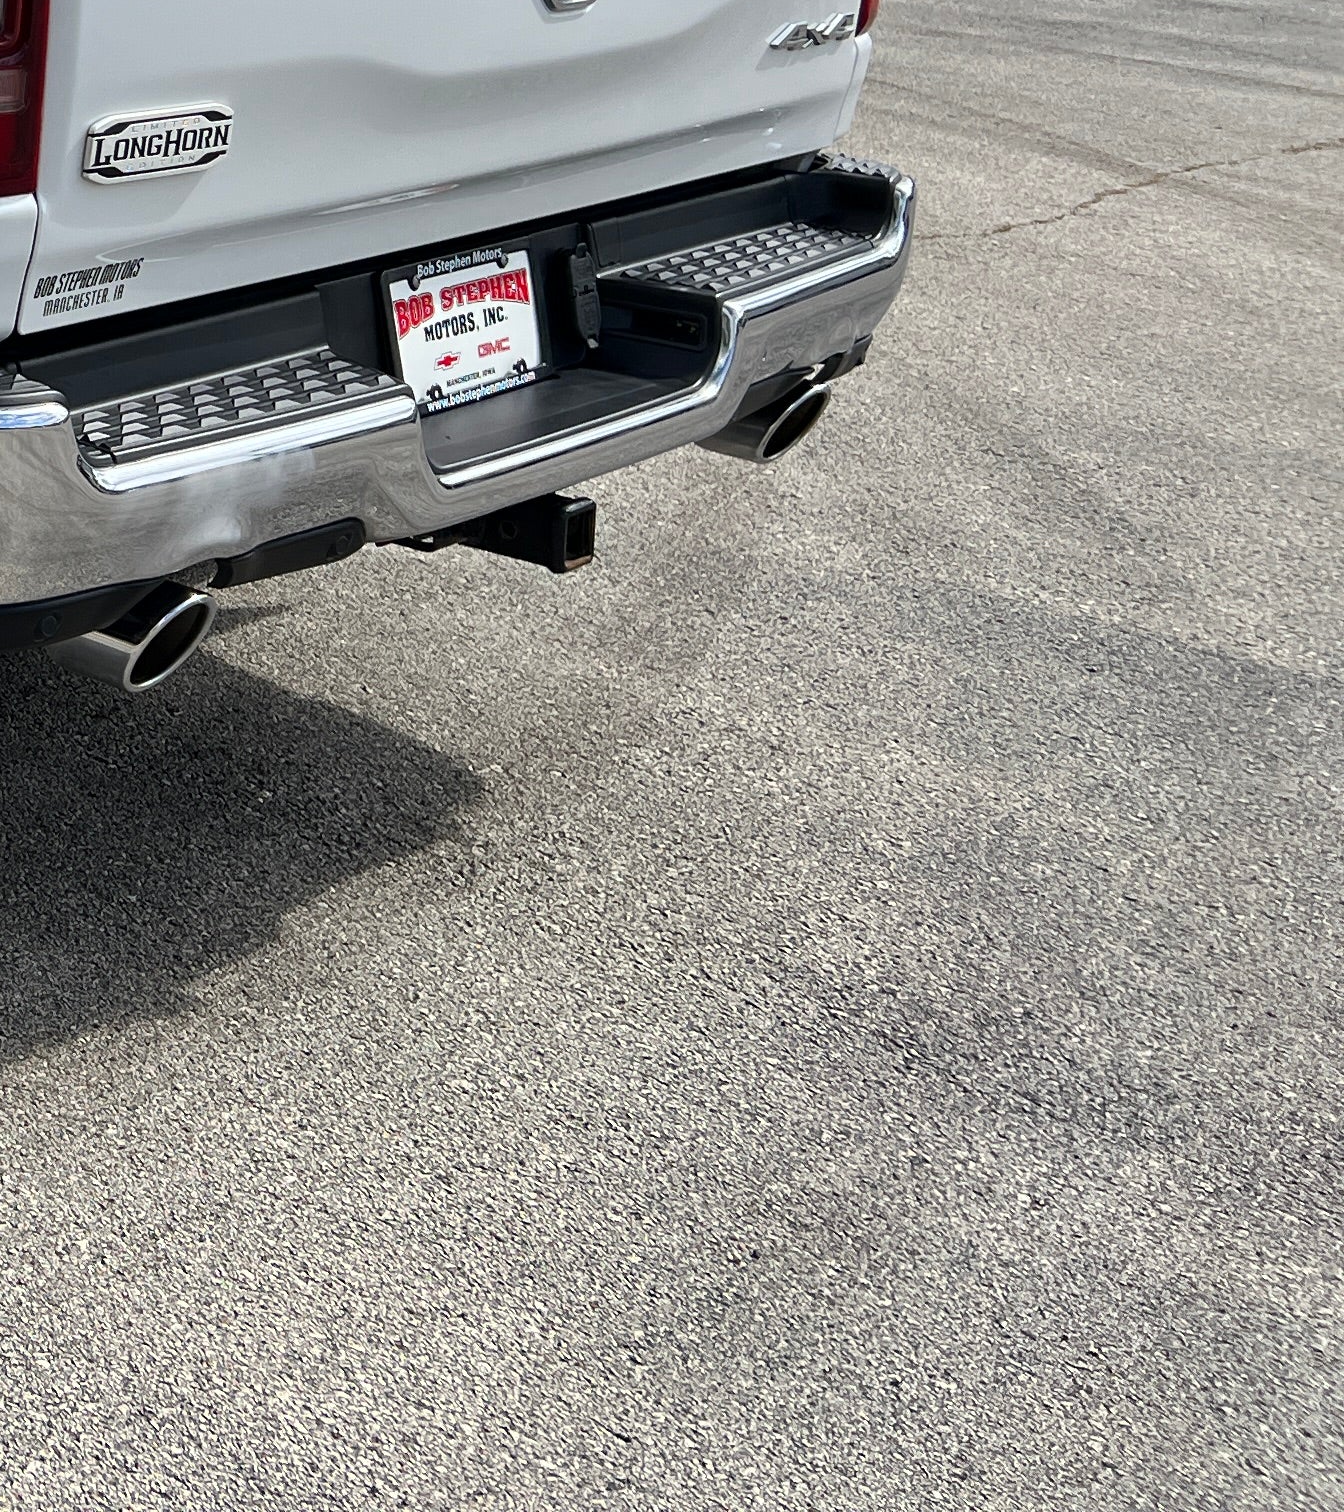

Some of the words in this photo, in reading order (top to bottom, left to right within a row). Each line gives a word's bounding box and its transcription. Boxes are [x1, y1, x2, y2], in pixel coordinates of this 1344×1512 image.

[131, 117, 201, 133] LIMITED
[91, 123, 232, 168] LONGHORN
[125, 154, 196, 172] EDITION
[33, 275, 58, 299] BOB
[56, 266, 103, 294] STEPHEN
[99, 257, 144, 285] MOTORS
[417, 262, 434, 279] Bob
[435, 255, 471, 273] Stephen
[472, 248, 502, 264] Motors
[113, 284, 125, 302] IA
[393, 292, 435, 340] BOB
[439, 267, 531, 311] STEPHEN
[424, 311, 480, 342] MOTORS,
[482, 306, 509, 327] INC.
[477, 337, 511, 358] GMC
[427, 371, 536, 412] www.bobstephenmotors.com
